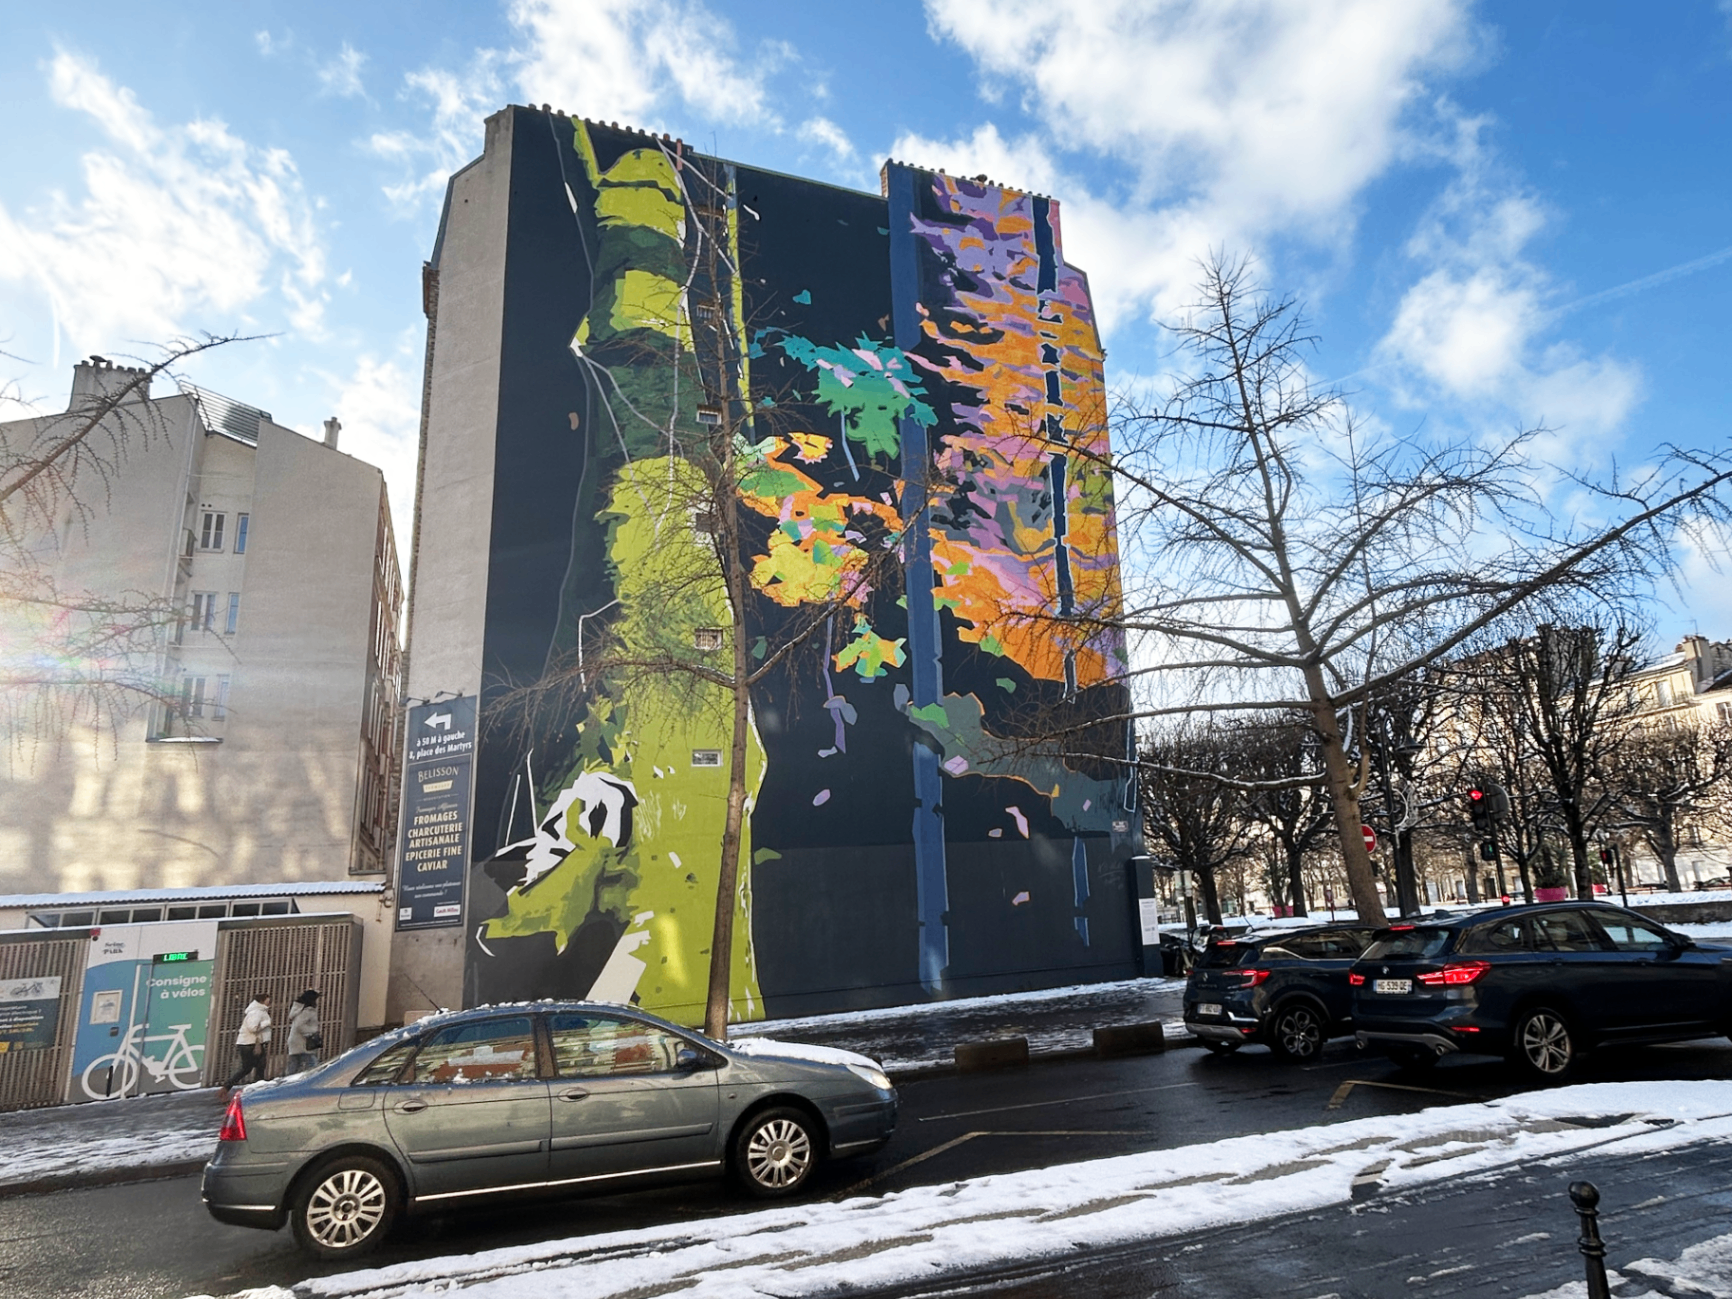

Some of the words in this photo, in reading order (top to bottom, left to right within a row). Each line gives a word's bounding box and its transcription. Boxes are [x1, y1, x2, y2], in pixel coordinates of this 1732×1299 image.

[416, 738, 421, 747] à
[422, 737, 430, 746] 50
[430, 735, 437, 744] M
[437, 734, 442, 743] à
[443, 730, 465, 744] gauche
[416, 748, 433, 760] place
[435, 746, 446, 755] des
[447, 741, 472, 752] Martyrs
[418, 766, 459, 783] BELISSON
[414, 810, 458, 826] FROMAGES
[408, 822, 463, 839] CHARCUTERIE
[409, 833, 460, 849] ARTISANALE
[405, 848, 441, 862] EPICERIE
[443, 846, 462, 857] FINE
[417, 860, 448, 872] CAVIAR
[163, 952, 188, 961] LIBRE
[160, 990, 169, 999] à
[172, 988, 206, 999] vélos
